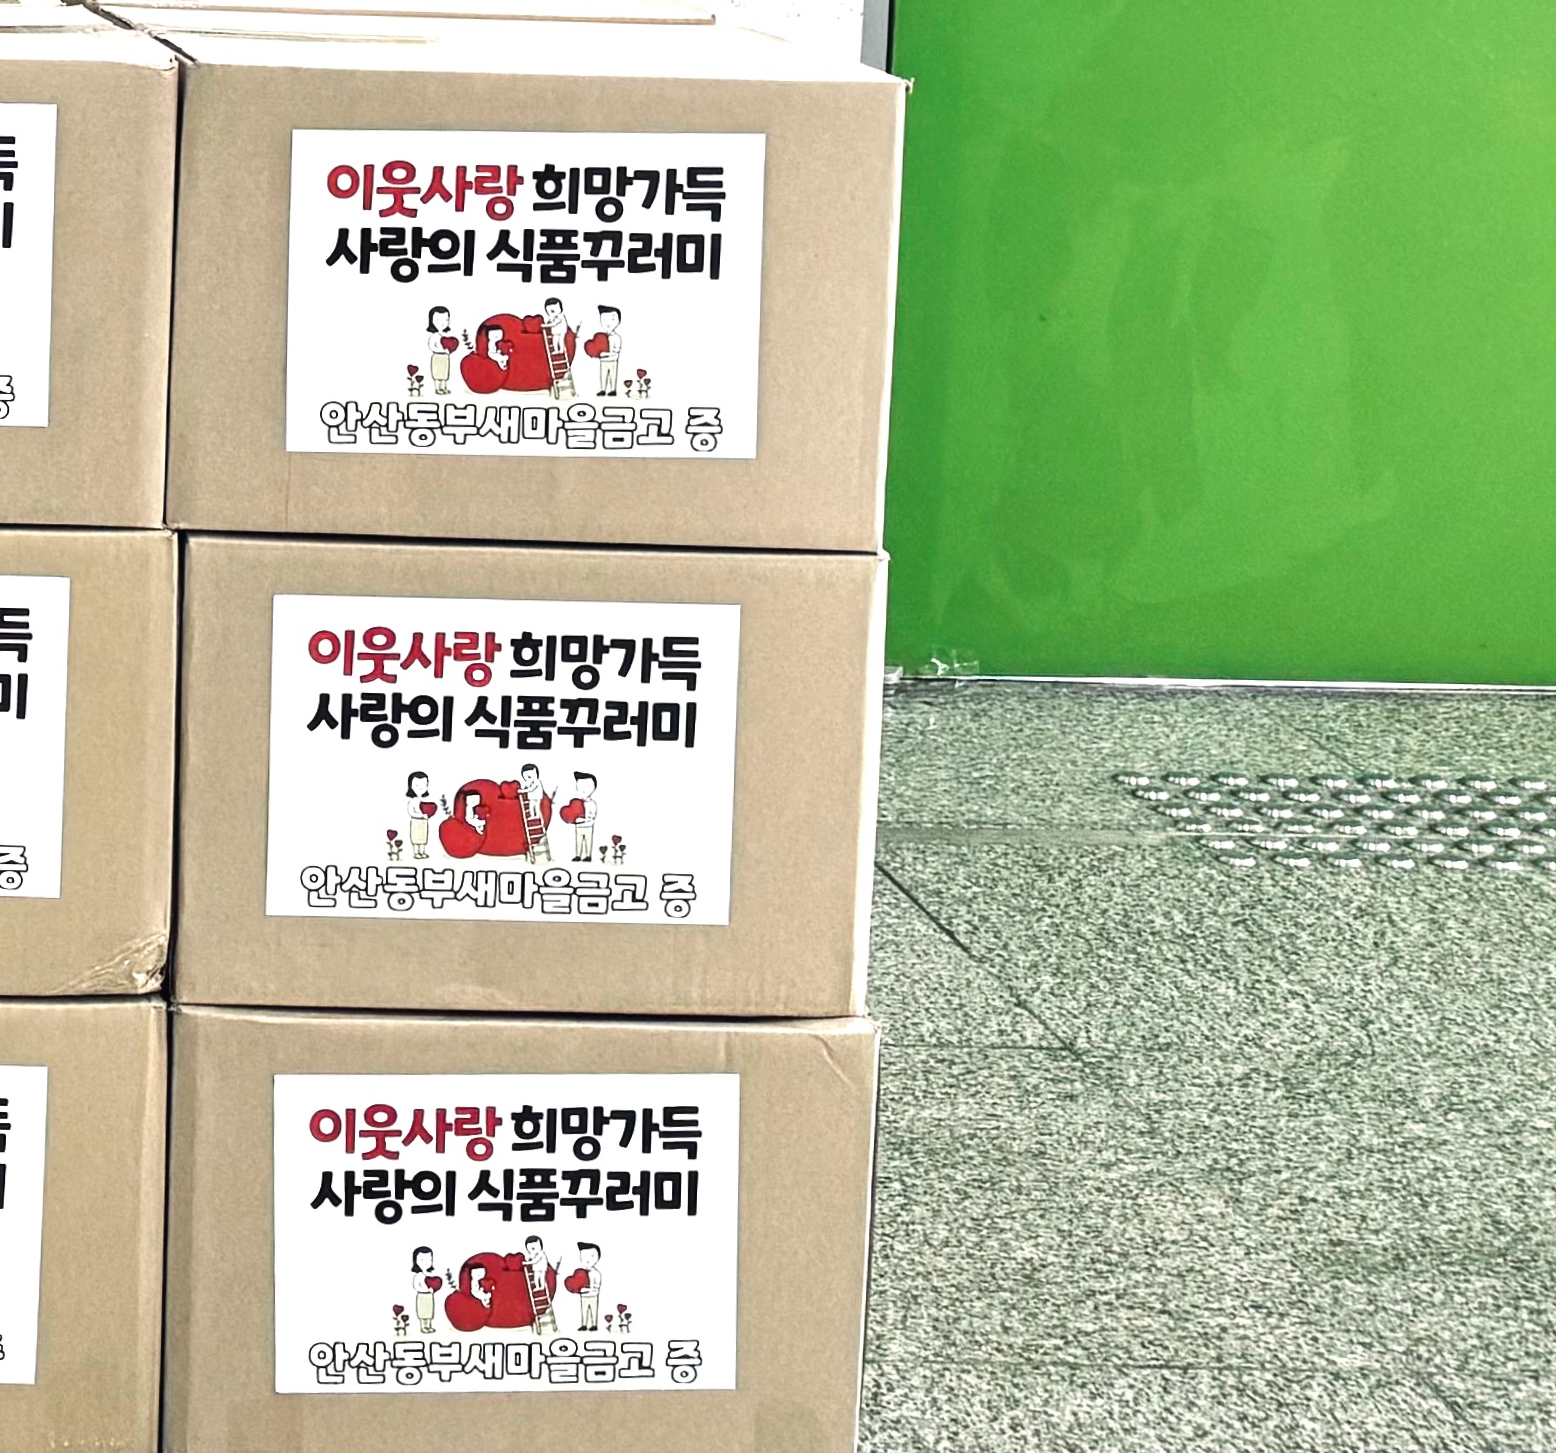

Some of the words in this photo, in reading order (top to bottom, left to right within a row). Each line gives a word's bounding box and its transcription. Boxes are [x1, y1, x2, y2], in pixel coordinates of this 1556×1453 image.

[324, 159, 525, 222] 이웃사랑
[531, 162, 728, 225] 희망가득
[324, 225, 477, 285] 사랑의
[485, 227, 724, 286] 식품꾸러미
[319, 400, 676, 451] 안산동부새마을금고
[684, 406, 725, 454] 증
[307, 1102, 503, 1163] 이웃사랑
[509, 1103, 703, 1163] 희망가득
[308, 1168, 458, 1226] 사랑의
[466, 1166, 699, 1224] 식품꾸러미
[307, 1337, 657, 1387] 안산동부새마을금고
[665, 1339, 704, 1385] 증
